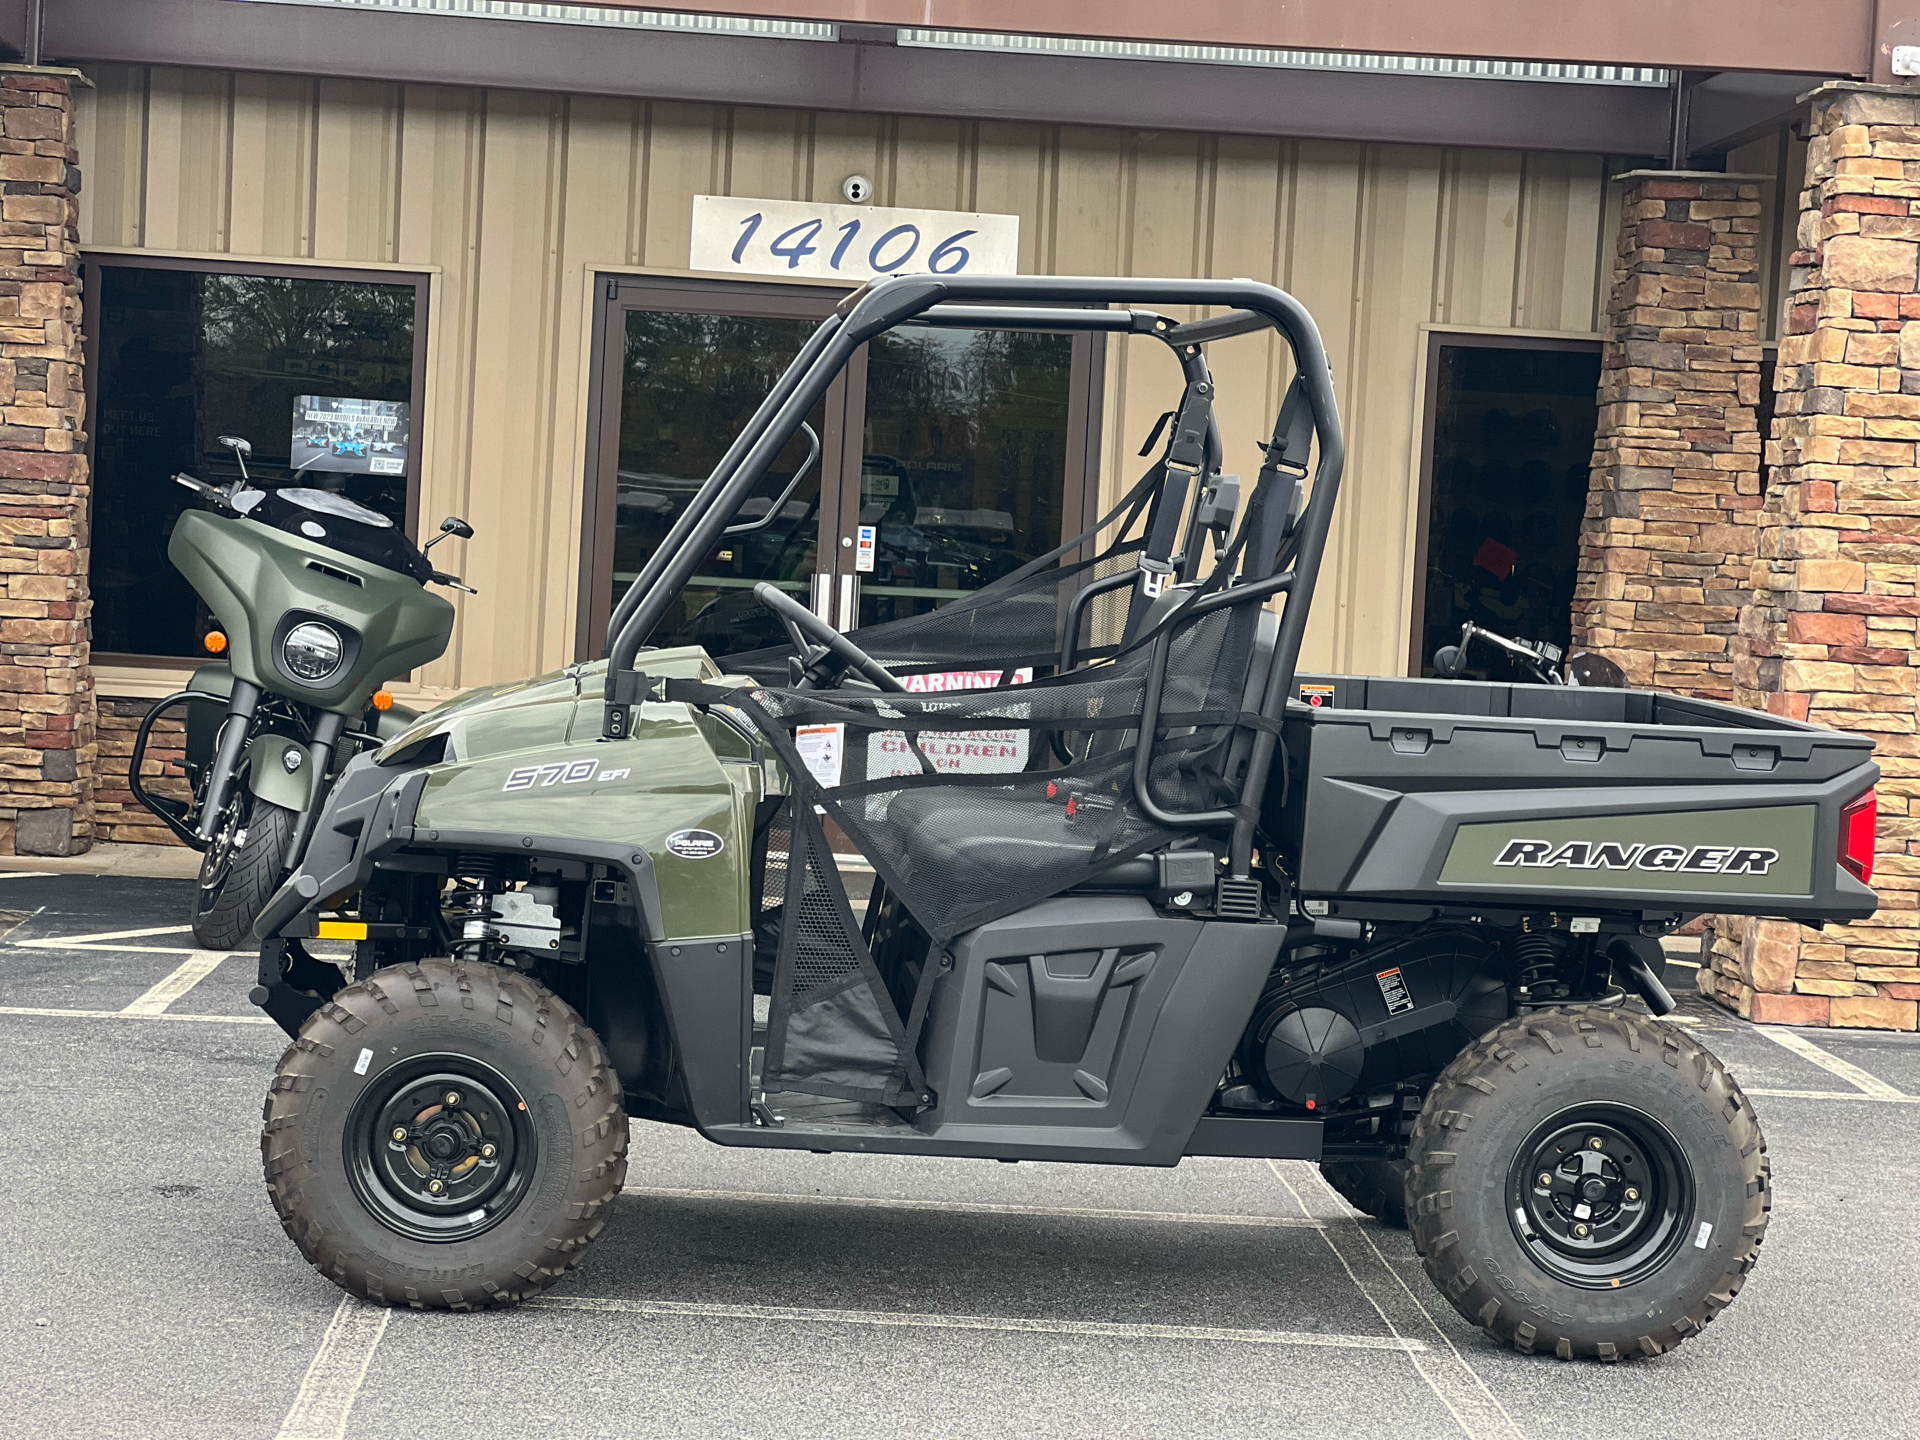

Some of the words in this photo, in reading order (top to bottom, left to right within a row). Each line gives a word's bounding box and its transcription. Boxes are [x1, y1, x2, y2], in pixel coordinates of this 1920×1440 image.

[731, 213, 979, 274] 14106
[306, 412, 319, 420] NEW
[319, 413, 333, 421] 2023
[334, 414, 355, 422] MODELS
[355, 415, 383, 424] AVAILABLE
[383, 417, 396, 425] NOW
[896, 460, 962, 472] POLARIS
[502, 759, 599, 791] 570
[598, 768, 631, 781] EFI
[936, 758, 960, 768] ON
[1493, 839, 1779, 875] RANGER
[1615, 1060, 1732, 1149] CARLISLE
[356, 1246, 485, 1282] CARLISLE
